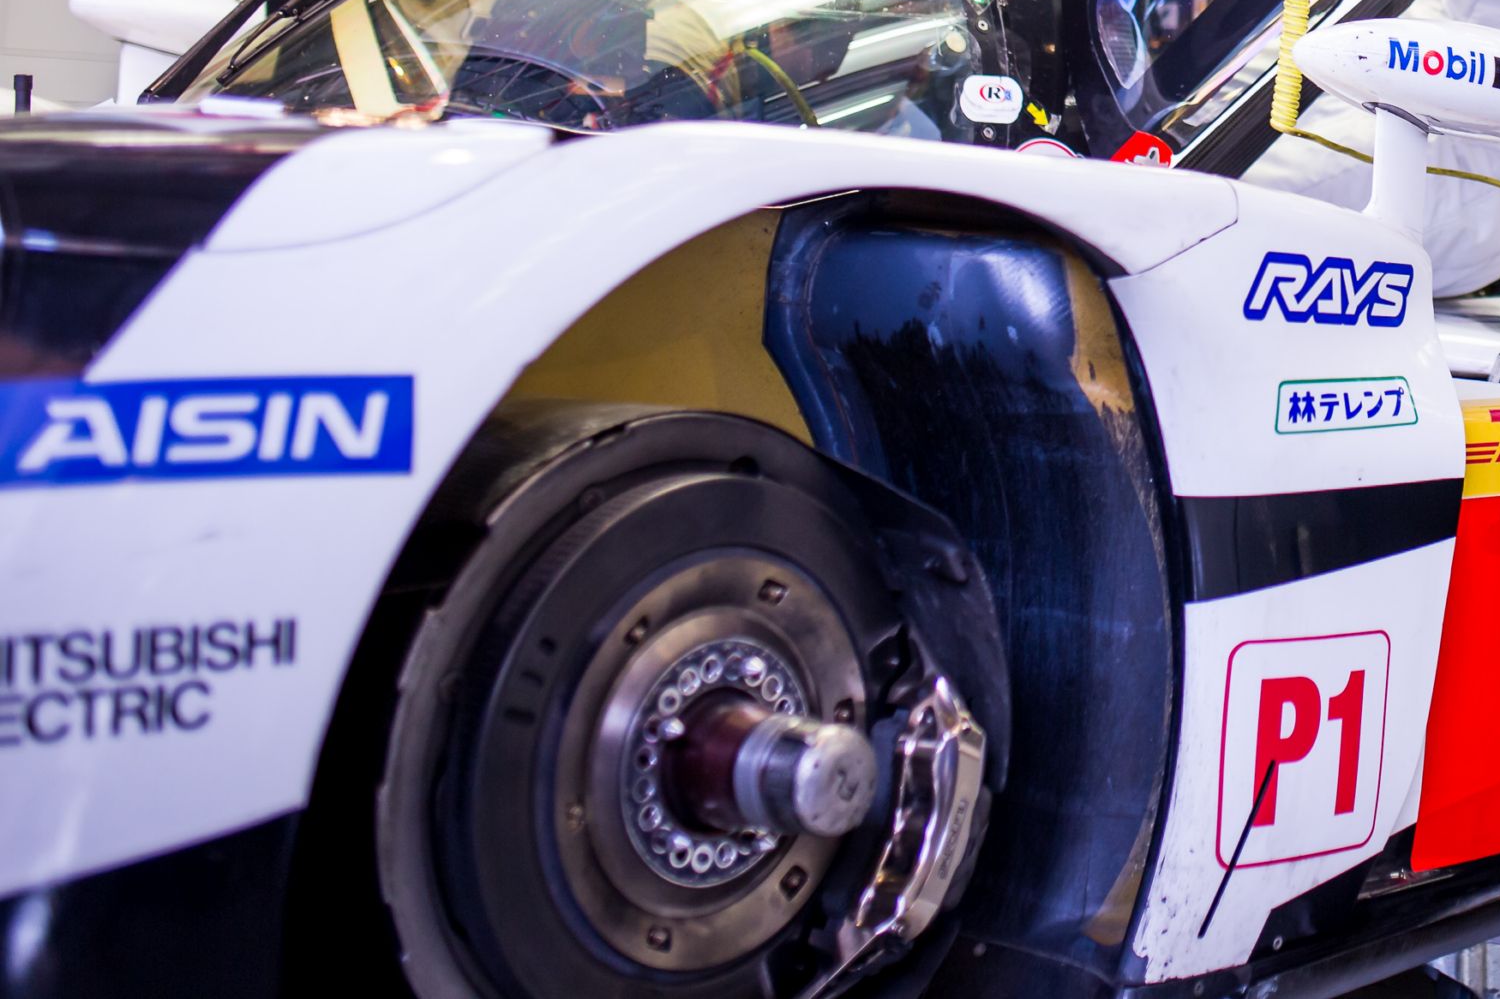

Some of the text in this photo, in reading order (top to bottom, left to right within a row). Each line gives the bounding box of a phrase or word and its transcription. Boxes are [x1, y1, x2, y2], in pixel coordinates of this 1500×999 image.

[1387, 37, 1486, 86] Mobil
[1243, 251, 1414, 327] RAYS
[16, 391, 390, 475] AISIN
[1288, 386, 1405, 423] 林テレンプ
[0, 618, 297, 688] ITSUBISHI
[1253, 669, 1366, 828] P1
